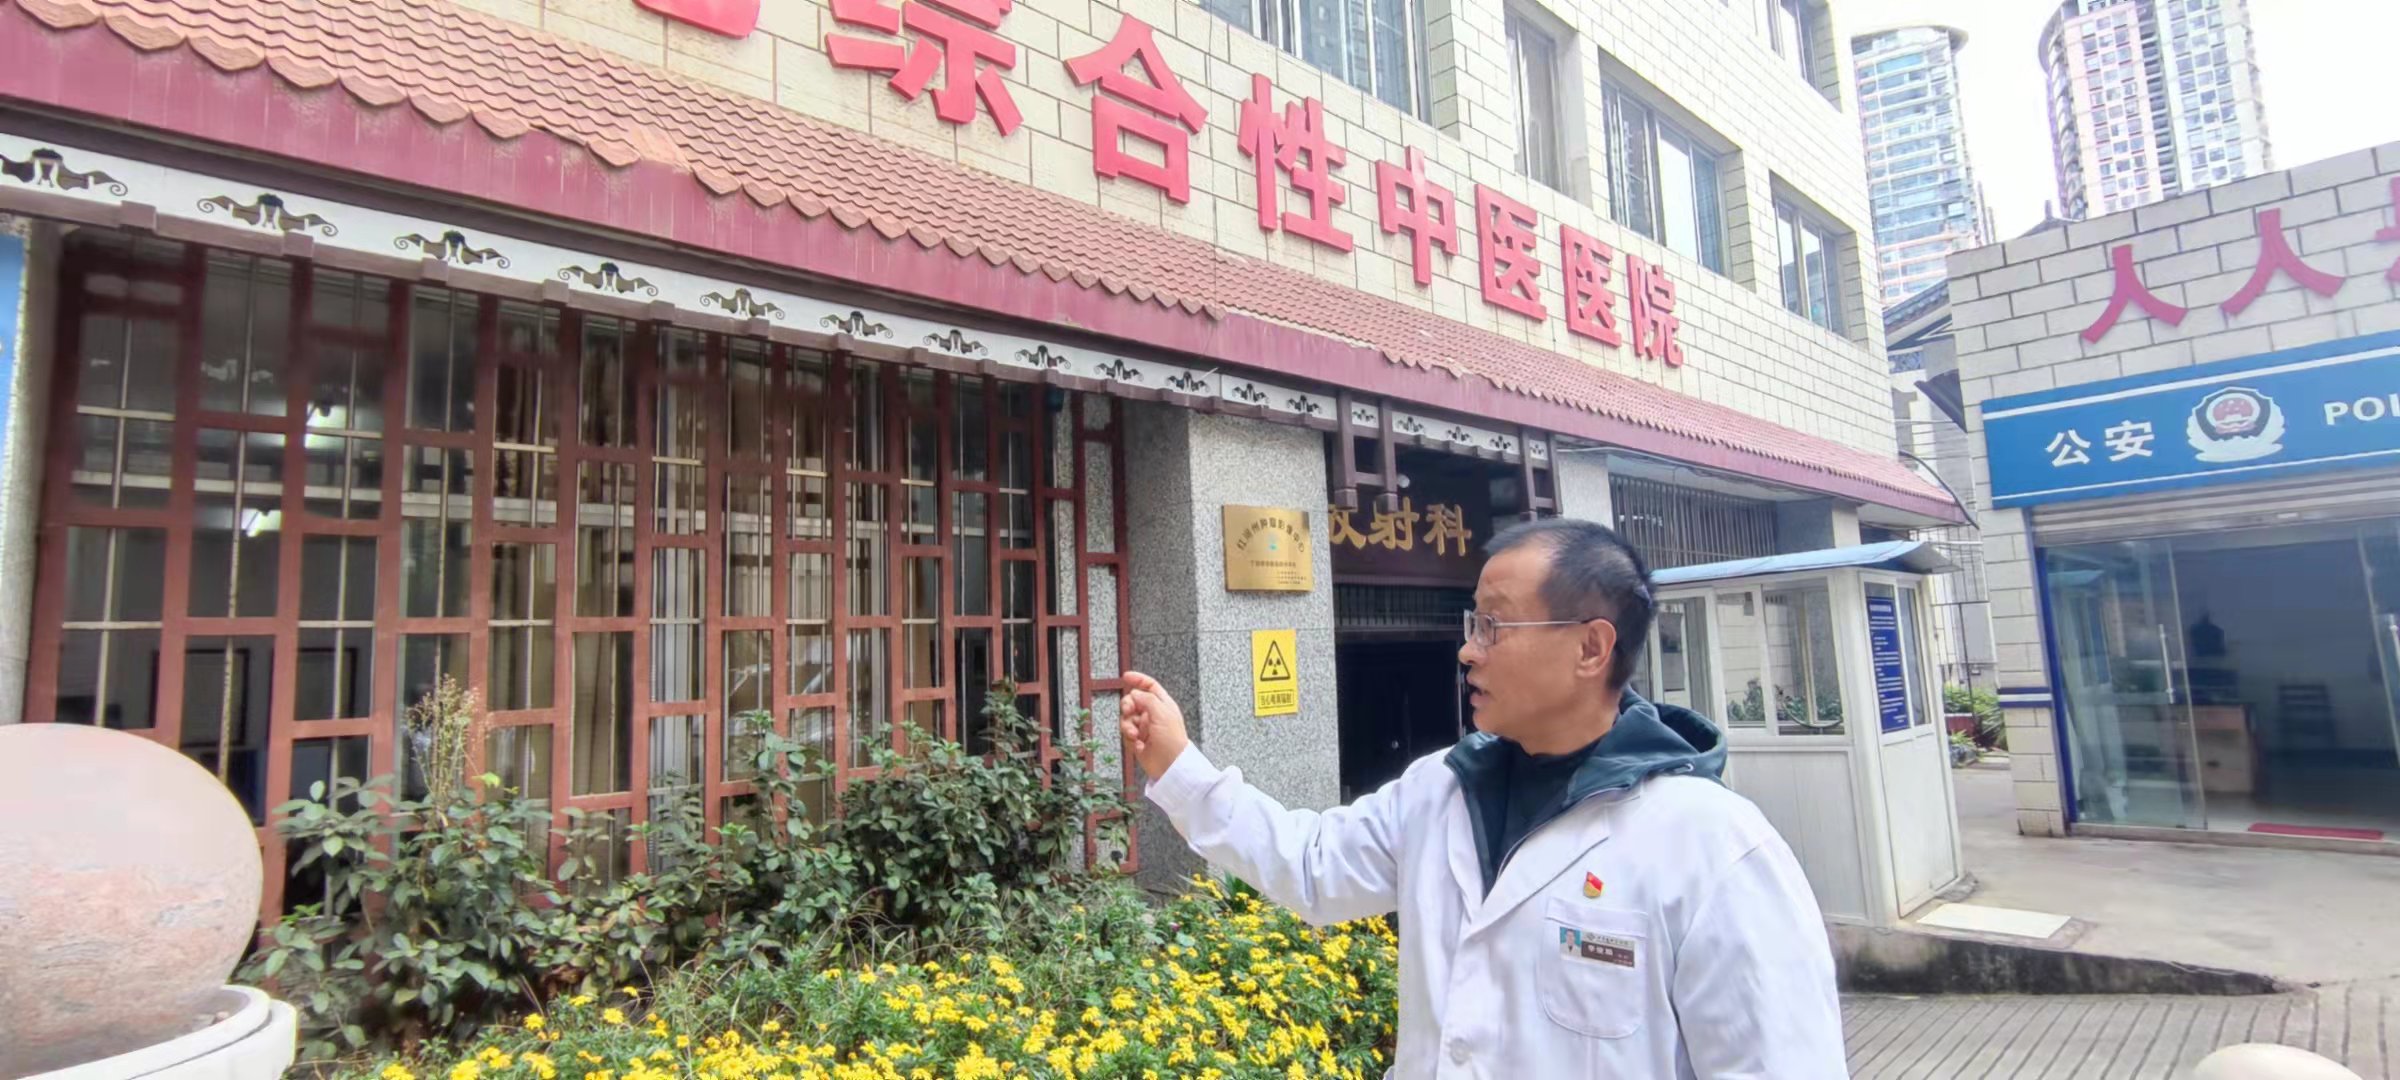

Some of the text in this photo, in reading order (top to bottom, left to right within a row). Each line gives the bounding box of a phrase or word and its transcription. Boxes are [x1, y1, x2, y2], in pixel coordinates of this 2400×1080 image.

[633, 0, 1684, 368] 综合性中医医院
[2080, 177, 2400, 344] 人人
[2045, 419, 2156, 468] 公安
